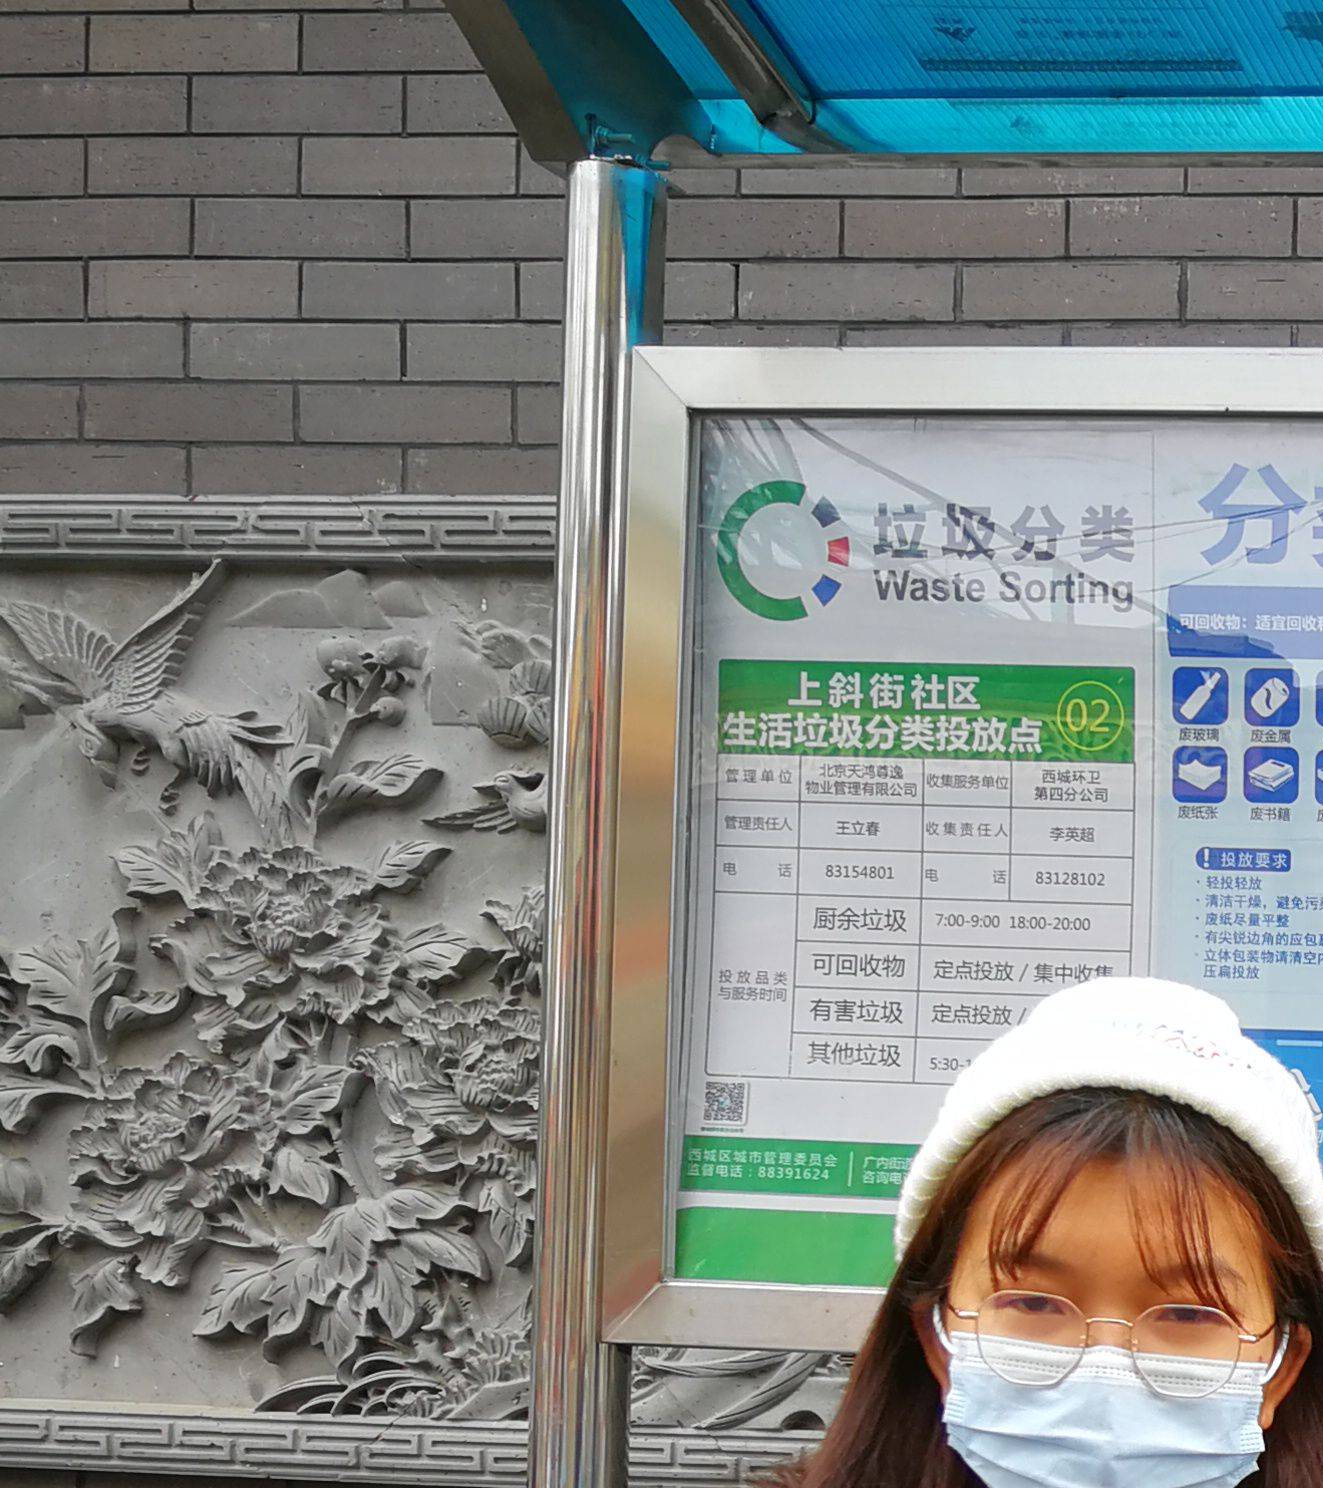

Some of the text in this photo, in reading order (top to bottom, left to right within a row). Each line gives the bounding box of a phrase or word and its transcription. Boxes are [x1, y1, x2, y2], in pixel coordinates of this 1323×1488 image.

[873, 502, 1136, 563] 垃圾分类
[874, 570, 1134, 613] Waste Sorting
[788, 672, 980, 710] 上斜街社区
[1065, 698, 1109, 733] 02
[723, 711, 1043, 755] 生活垃圾分类投放点
[1179, 728, 1220, 744] 废玻璃
[1251, 728, 1291, 745] 废金属
[725, 768, 793, 786] 管理单位
[926, 772, 1009, 791] 收集服务单位
[1042, 769, 1101, 786] 西城环卫
[805, 779, 917, 798] 物业管理有限公司
[1034, 786, 1108, 803] 第四分公司
[1177, 805, 1218, 821] 废纸张
[724, 815, 793, 833] 管理责任人
[836, 820, 880, 837] 王立春
[925, 820, 1009, 839] 收集责任人
[1049, 826, 1095, 844] 李英超
[824, 863, 895, 881] 83154801
[1034, 870, 1105, 888] 83128102
[1206, 876, 1262, 890] 轻投轻放
[812, 907, 907, 935] 厨余垃圾
[934, 912, 1091, 931] 7:00-9:00 18:00-20:00
[812, 953, 906, 979] 可回收物
[1203, 965, 1260, 980] 压扁投放
[718, 968, 788, 986] 投放品类
[717, 983, 788, 1003] 与服务时间
[810, 998, 903, 1025] 有害垃圾
[807, 1041, 901, 1067] 其他垃圾
[687, 1149, 838, 1168] 西城区城市管理委员会
